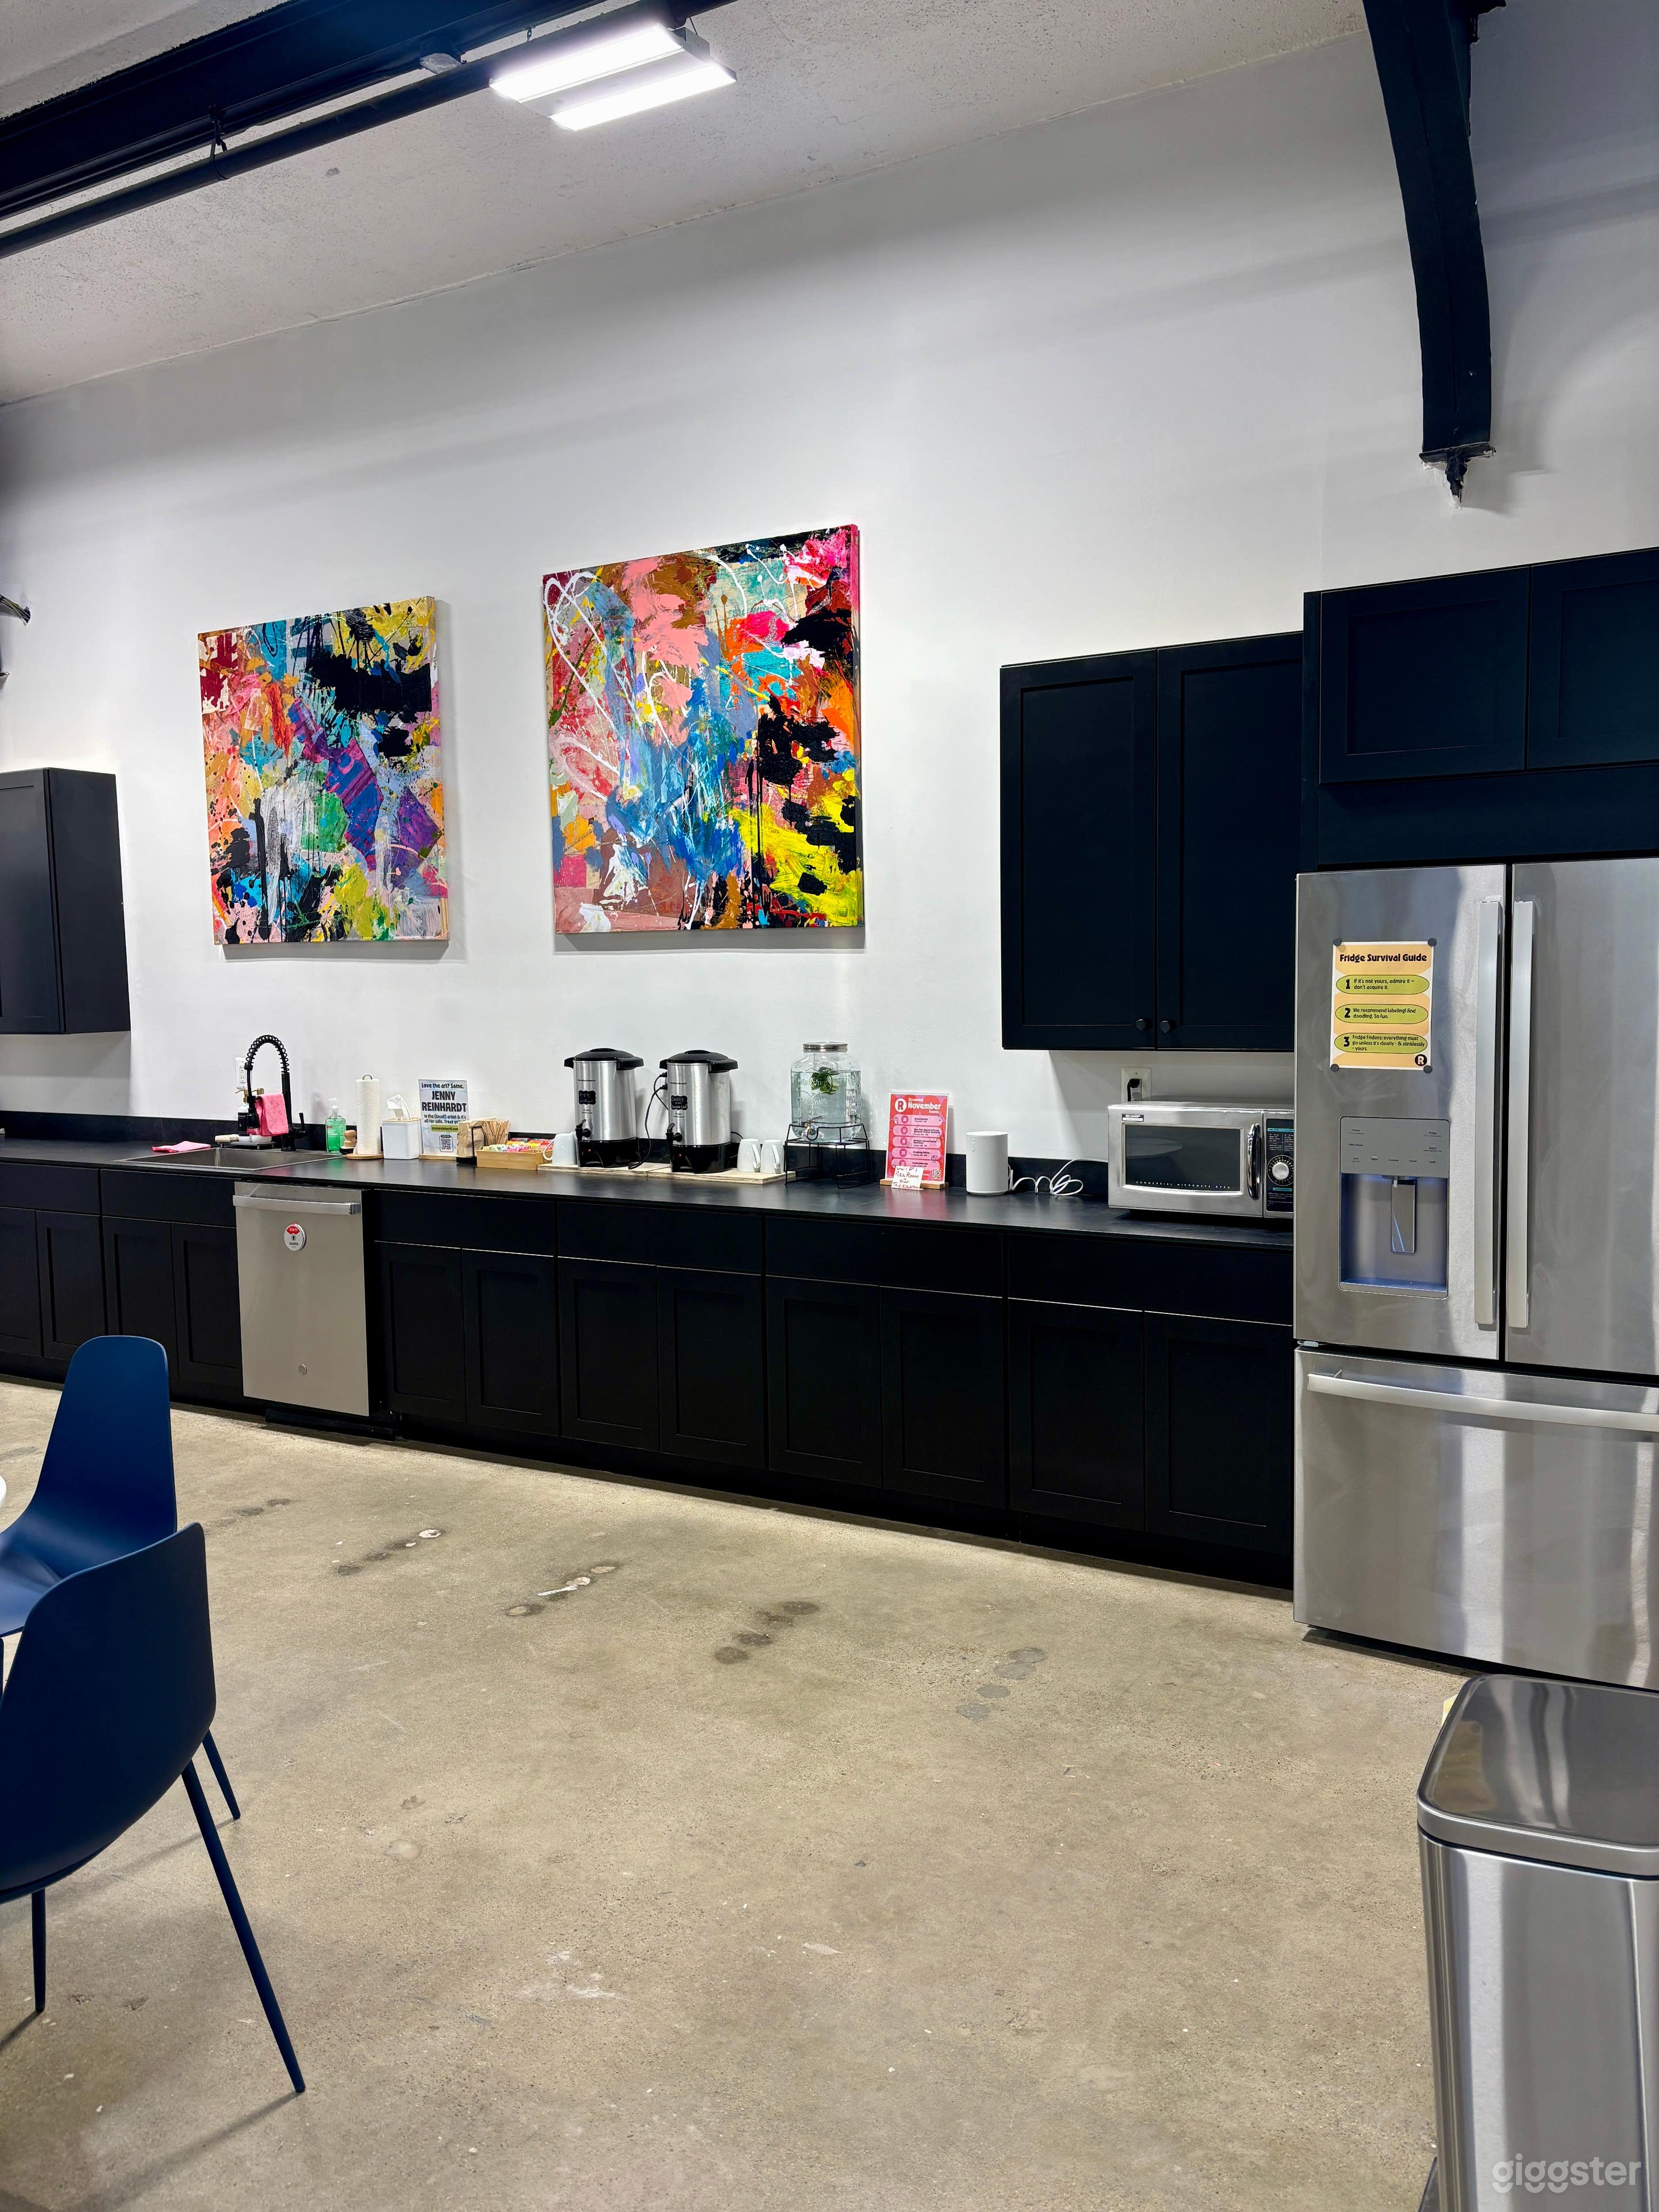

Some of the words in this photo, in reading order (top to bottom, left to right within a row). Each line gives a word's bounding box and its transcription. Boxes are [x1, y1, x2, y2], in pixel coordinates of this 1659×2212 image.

[1340, 954, 1365, 963] Fridge
[1367, 953, 1400, 961] Survival
[1403, 953, 1427, 961] Guide
[1346, 979, 1350, 989] 1
[1344, 1007, 1350, 1018] 2
[1344, 1036, 1350, 1047] 3
[1418, 1056, 1424, 1065] R
[432, 1091, 456, 1100] JENNY
[422, 1102, 467, 1112] REINHARDT
[898, 1101, 904, 1110] R
[908, 1101, 941, 1110] November
